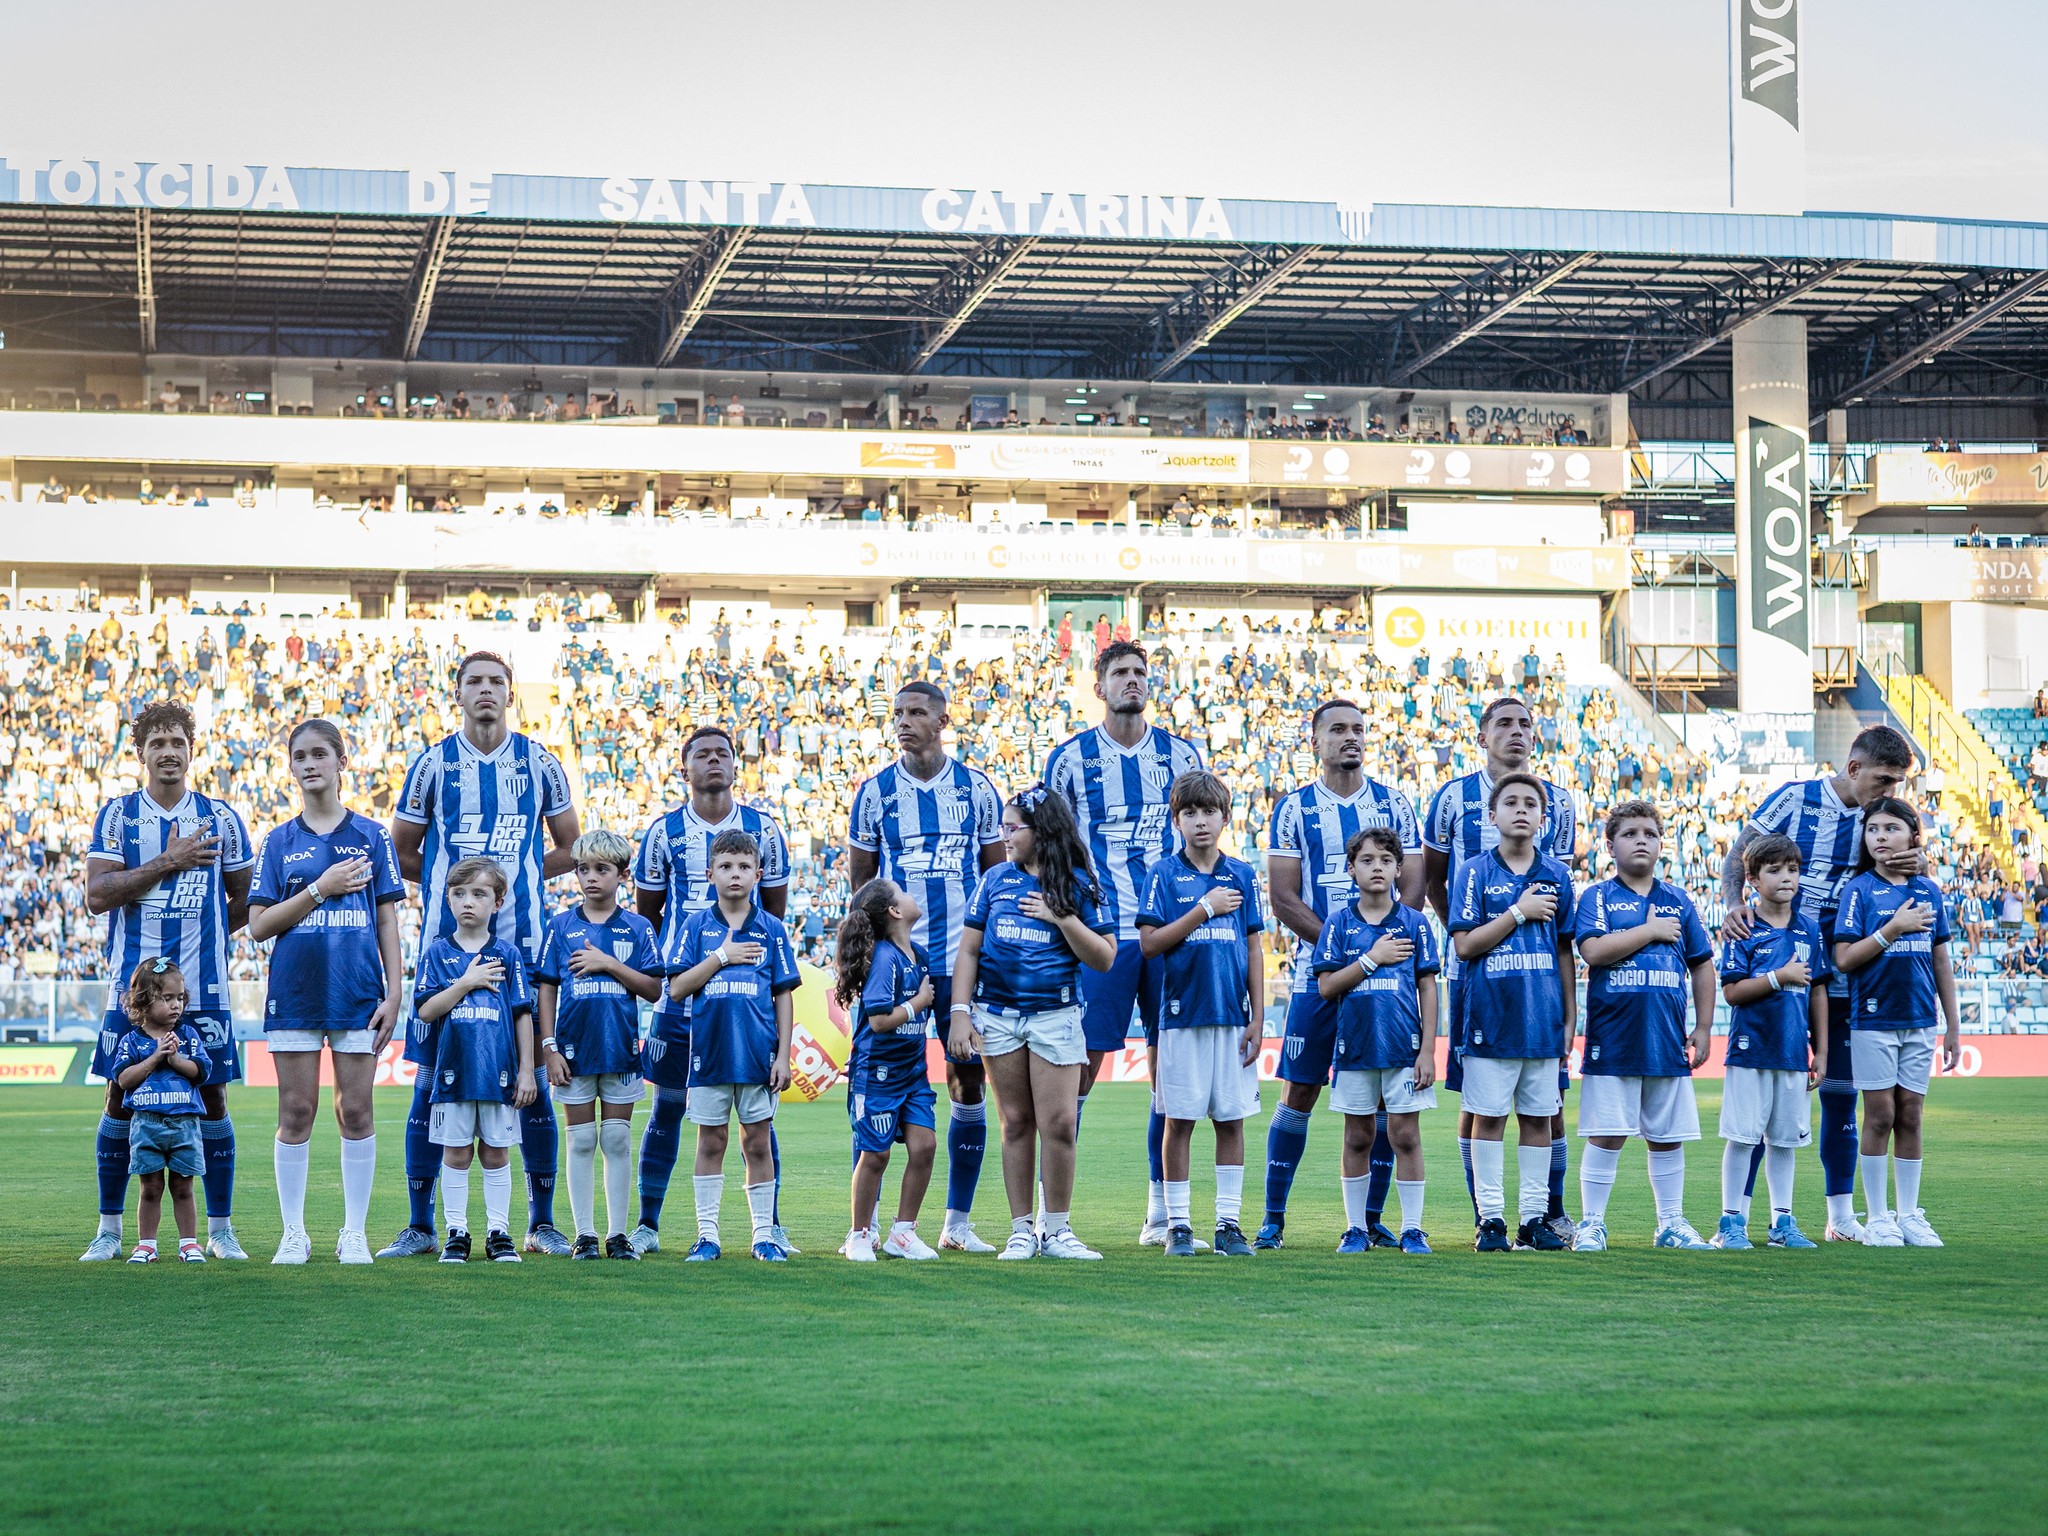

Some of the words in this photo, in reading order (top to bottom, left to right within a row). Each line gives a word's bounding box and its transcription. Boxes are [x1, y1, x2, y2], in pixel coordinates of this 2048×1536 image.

[6, 154, 299, 210] TORCIDA
[408, 169, 490, 215] DE
[599, 177, 817, 226] SANTA
[921, 188, 1235, 241] CATARINA
[1072, 460, 1104, 468] TINTAS
[1172, 455, 1236, 468] quartzolit
[1438, 618, 1589, 640] KOERICH
[1747, 746, 1805, 765] TAPERA
[442, 761, 474, 772] WOA
[496, 759, 528, 769] WOA
[1082, 757, 1115, 769] WOA
[1142, 803, 1170, 816] um
[1301, 806, 1333, 816] WOA
[1463, 800, 1489, 810] WO
[1802, 805, 1836, 821] WOA
[122, 815, 155, 827] WOA
[494, 814, 528, 827] um
[490, 826, 527, 842] pra
[938, 834, 970, 846] um
[668, 834, 700, 848] WOA
[334, 845, 368, 856] WOA
[283, 851, 314, 865] WOA
[178, 870, 209, 883] um
[1606, 902, 1638, 913] WOA
[1655, 905, 1682, 917] WOA
[328, 910, 367, 928] MIRIM
[1021, 928, 1051, 944] MIRIM
[730, 981, 758, 996] MIRIM
[1370, 978, 1399, 991] MIRIM
[475, 1006, 500, 1022] MIRIM
[160, 1091, 191, 1104] MIRIM
[1842, 1123, 1857, 1131] AF
[959, 1143, 984, 1151] AFC
[1269, 1159, 1290, 1168] AFC
